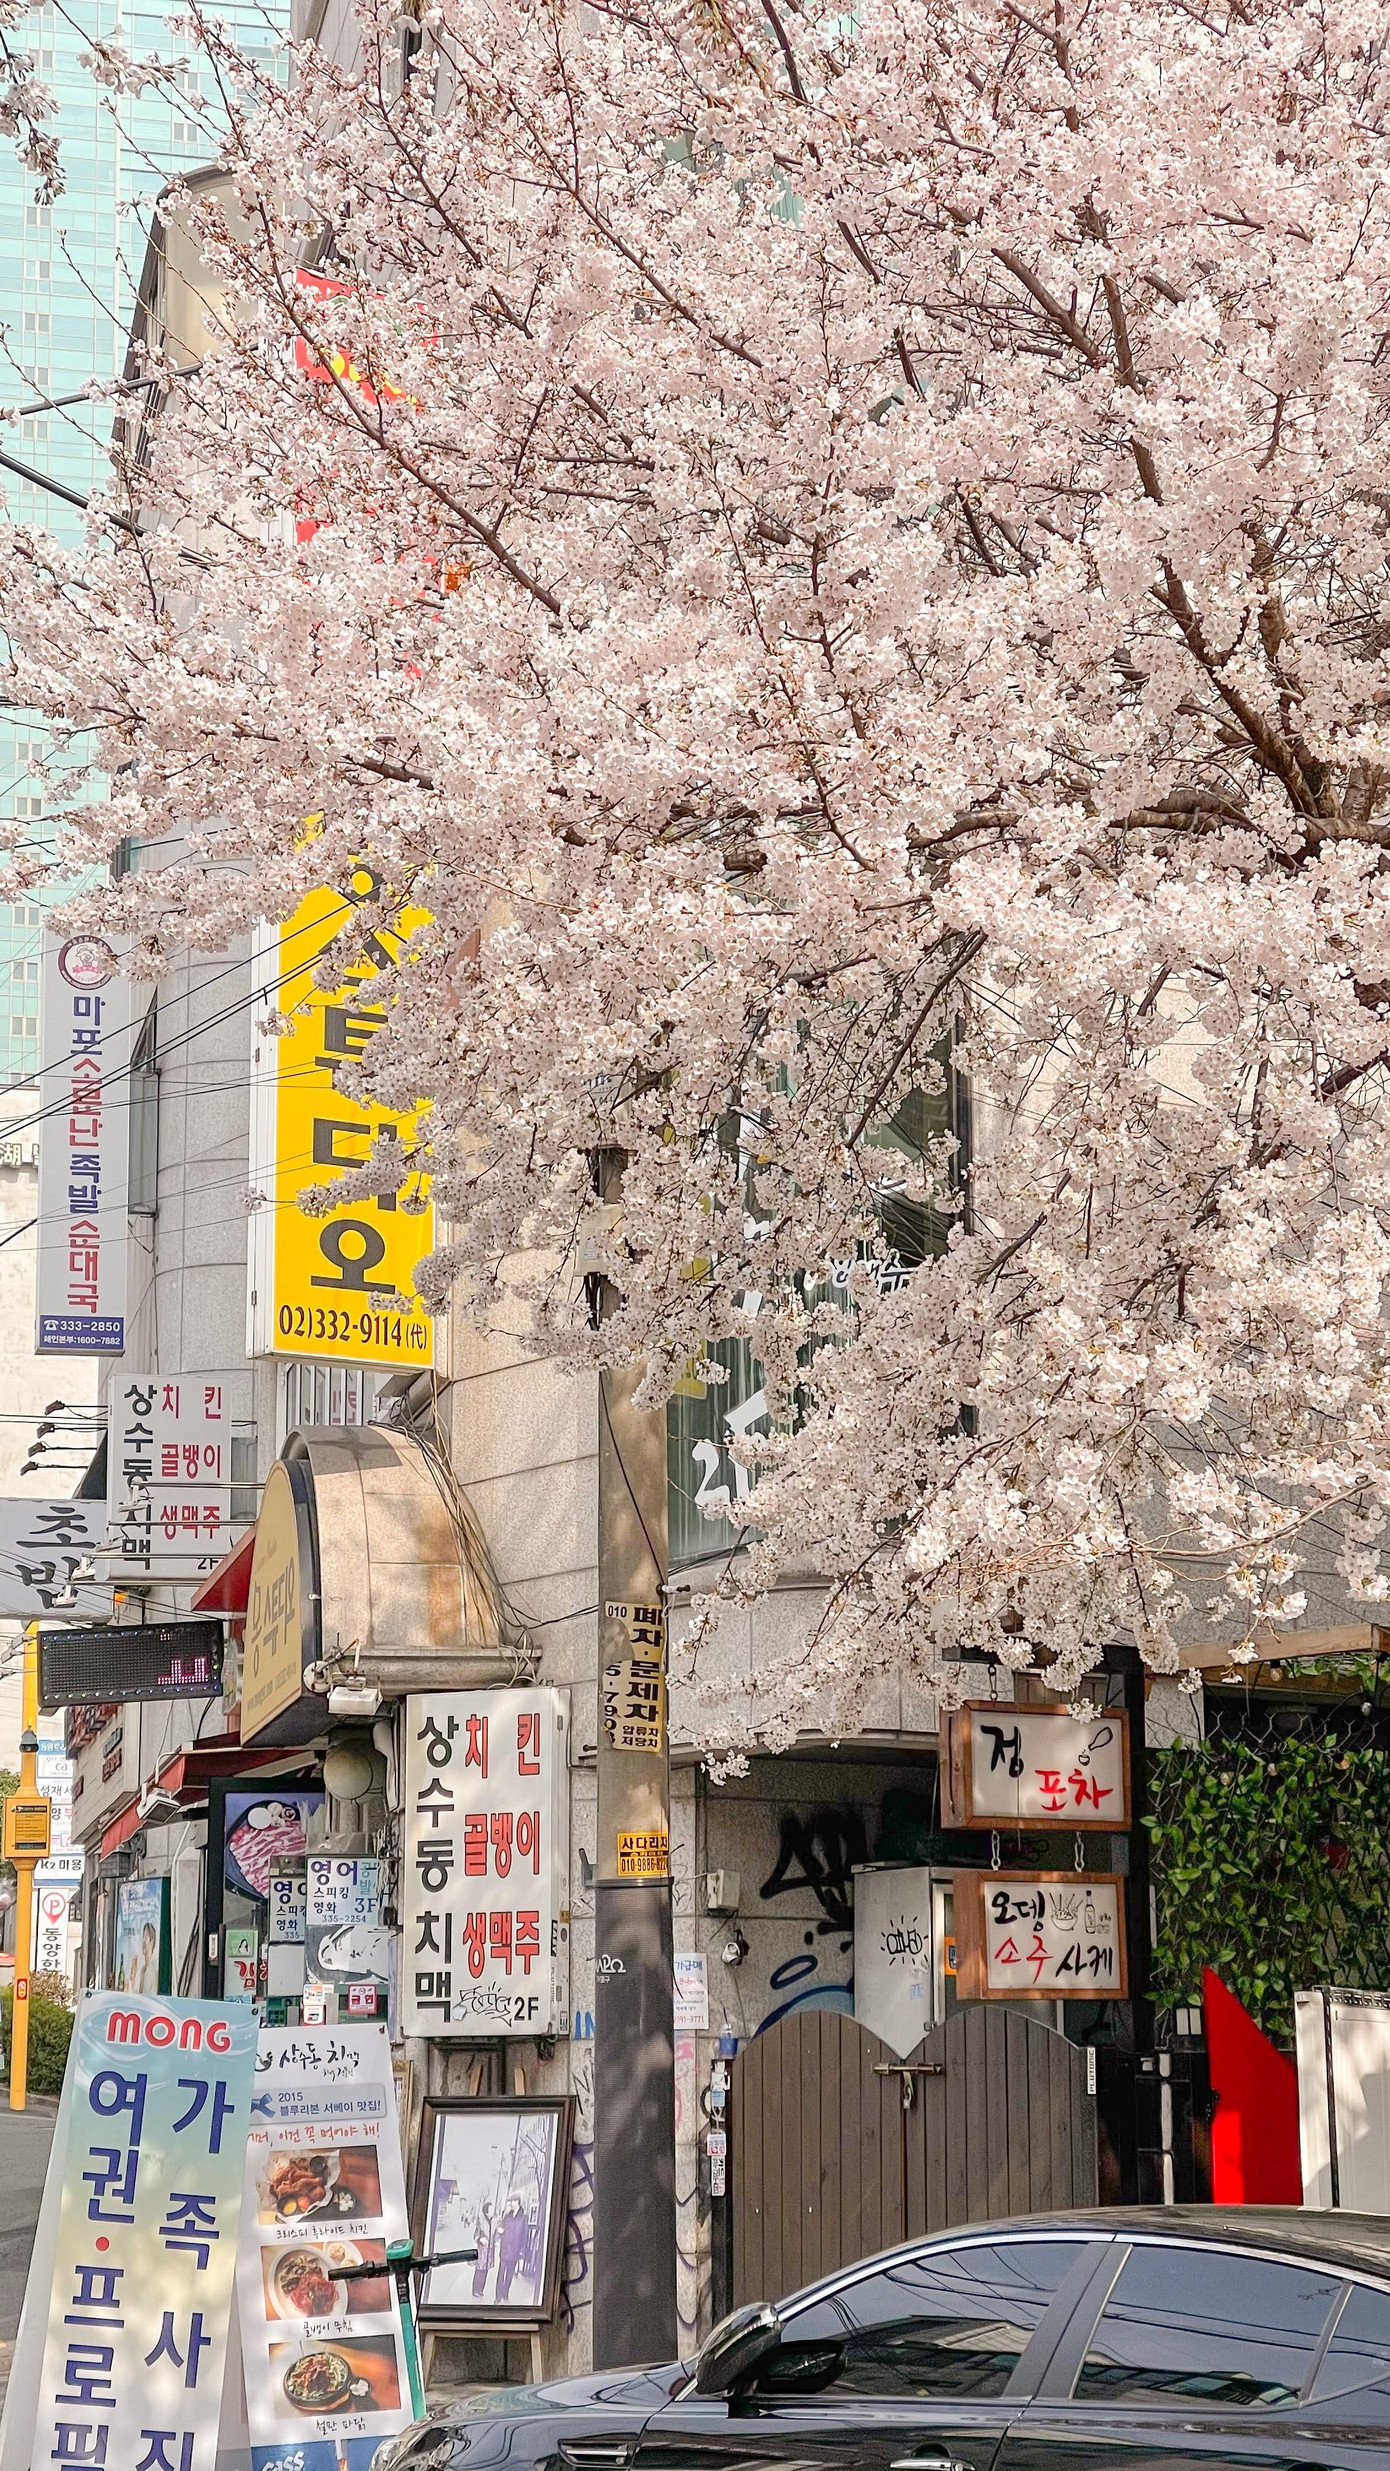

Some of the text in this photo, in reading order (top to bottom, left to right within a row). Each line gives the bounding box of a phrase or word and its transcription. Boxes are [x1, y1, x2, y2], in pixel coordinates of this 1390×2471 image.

[60, 1320, 120, 1332] 333-2850
[161, 1444, 221, 1479] 골뱅이
[160, 1505, 221, 1541] 생맥주
[1035, 1768, 1114, 1812] 포차
[464, 1811, 540, 1879] 골뱅이
[310, 1860, 358, 1886] 영어
[313, 1887, 349, 1899] 스피킹
[313, 1901, 337, 1914] 영화
[354, 1897, 379, 1913] 3F
[276, 1919, 298, 1931] 영화
[322, 1914, 367, 1923] 335-2254
[463, 1910, 540, 1979] 생맥주
[994, 1934, 1054, 1985] 소주
[1055, 1942, 1113, 1978] 사케
[514, 1996, 539, 2021] 2F
[279, 2043, 322, 2070] 상수동
[278, 2091, 304, 2103] 2015
[280, 2100, 381, 2117] 블루리본 서베이 맛집!
[278, 2129, 302, 2143] 이건
[303, 2125, 316, 2144] 꼭
[320, 2125, 358, 2142] 먹어야
[362, 2121, 380, 2139] 해!
[276, 2222, 369, 2240] 크리스피 후라이드 치킨
[303, 2318, 354, 2338] 골뱅이 무침
[316, 2416, 367, 2435] 철판 파닭
